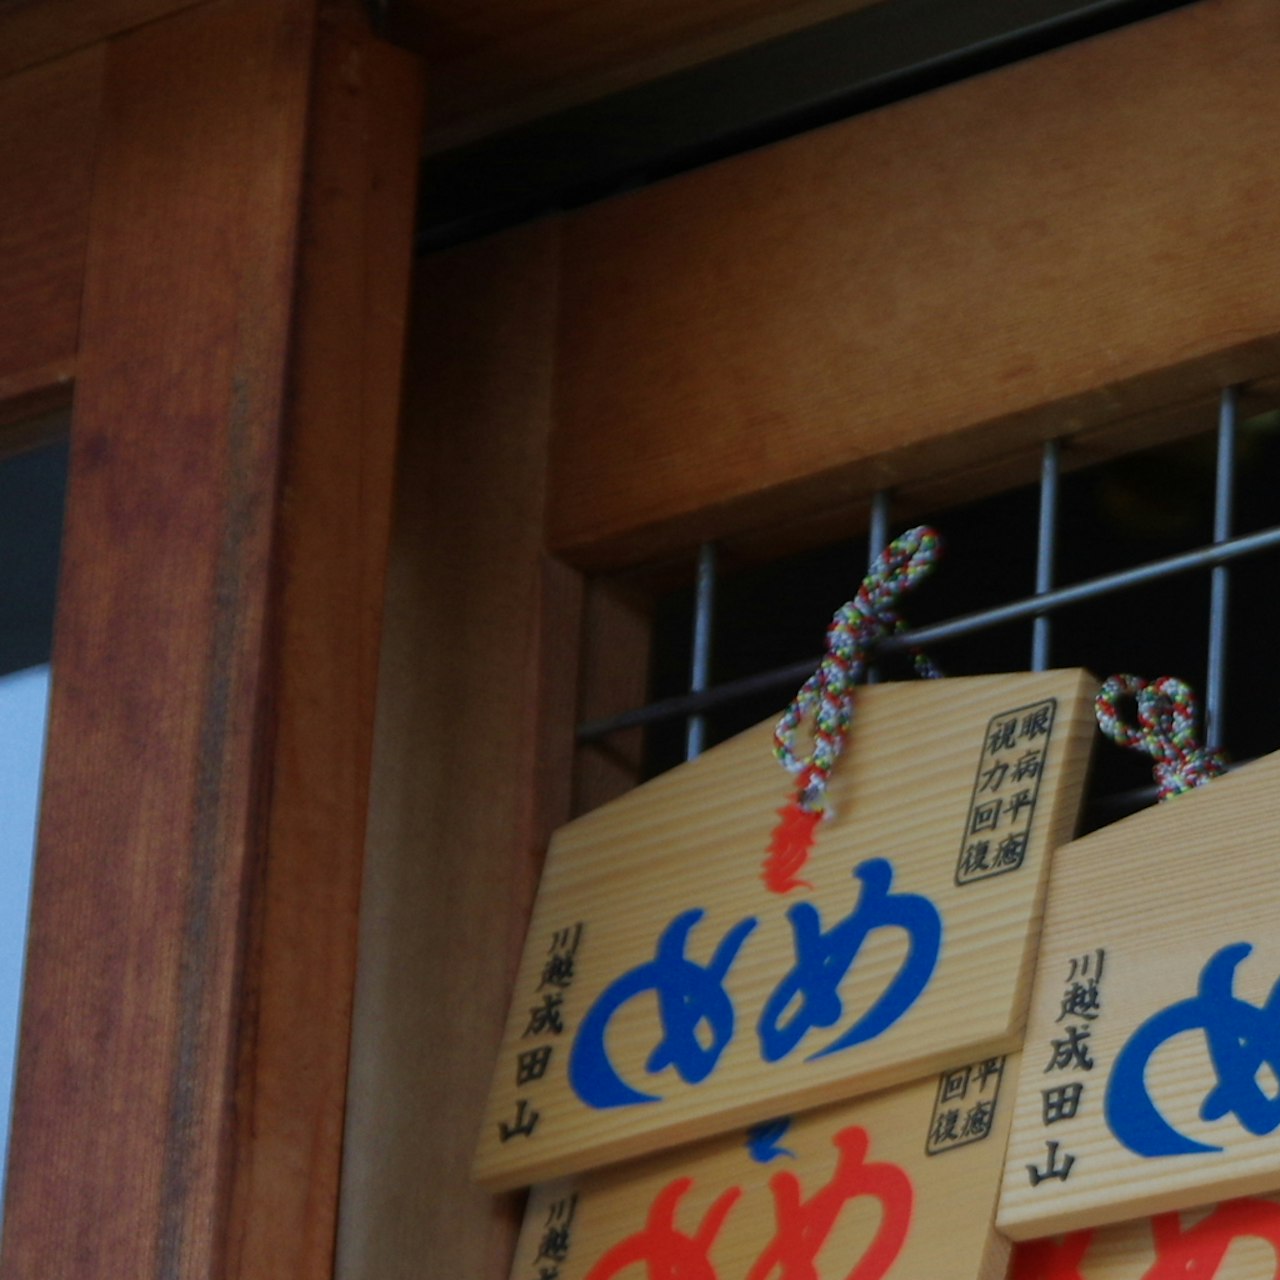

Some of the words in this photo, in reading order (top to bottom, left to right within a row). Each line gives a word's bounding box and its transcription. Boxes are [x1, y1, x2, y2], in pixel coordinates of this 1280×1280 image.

[960, 718, 1017, 873] 視力回復
[992, 702, 1054, 868] 眼病平癒
[500, 922, 581, 1141] 川越成田山
[567, 858, 941, 1110] めめ
[1026, 950, 1104, 1187] 川越成田山
